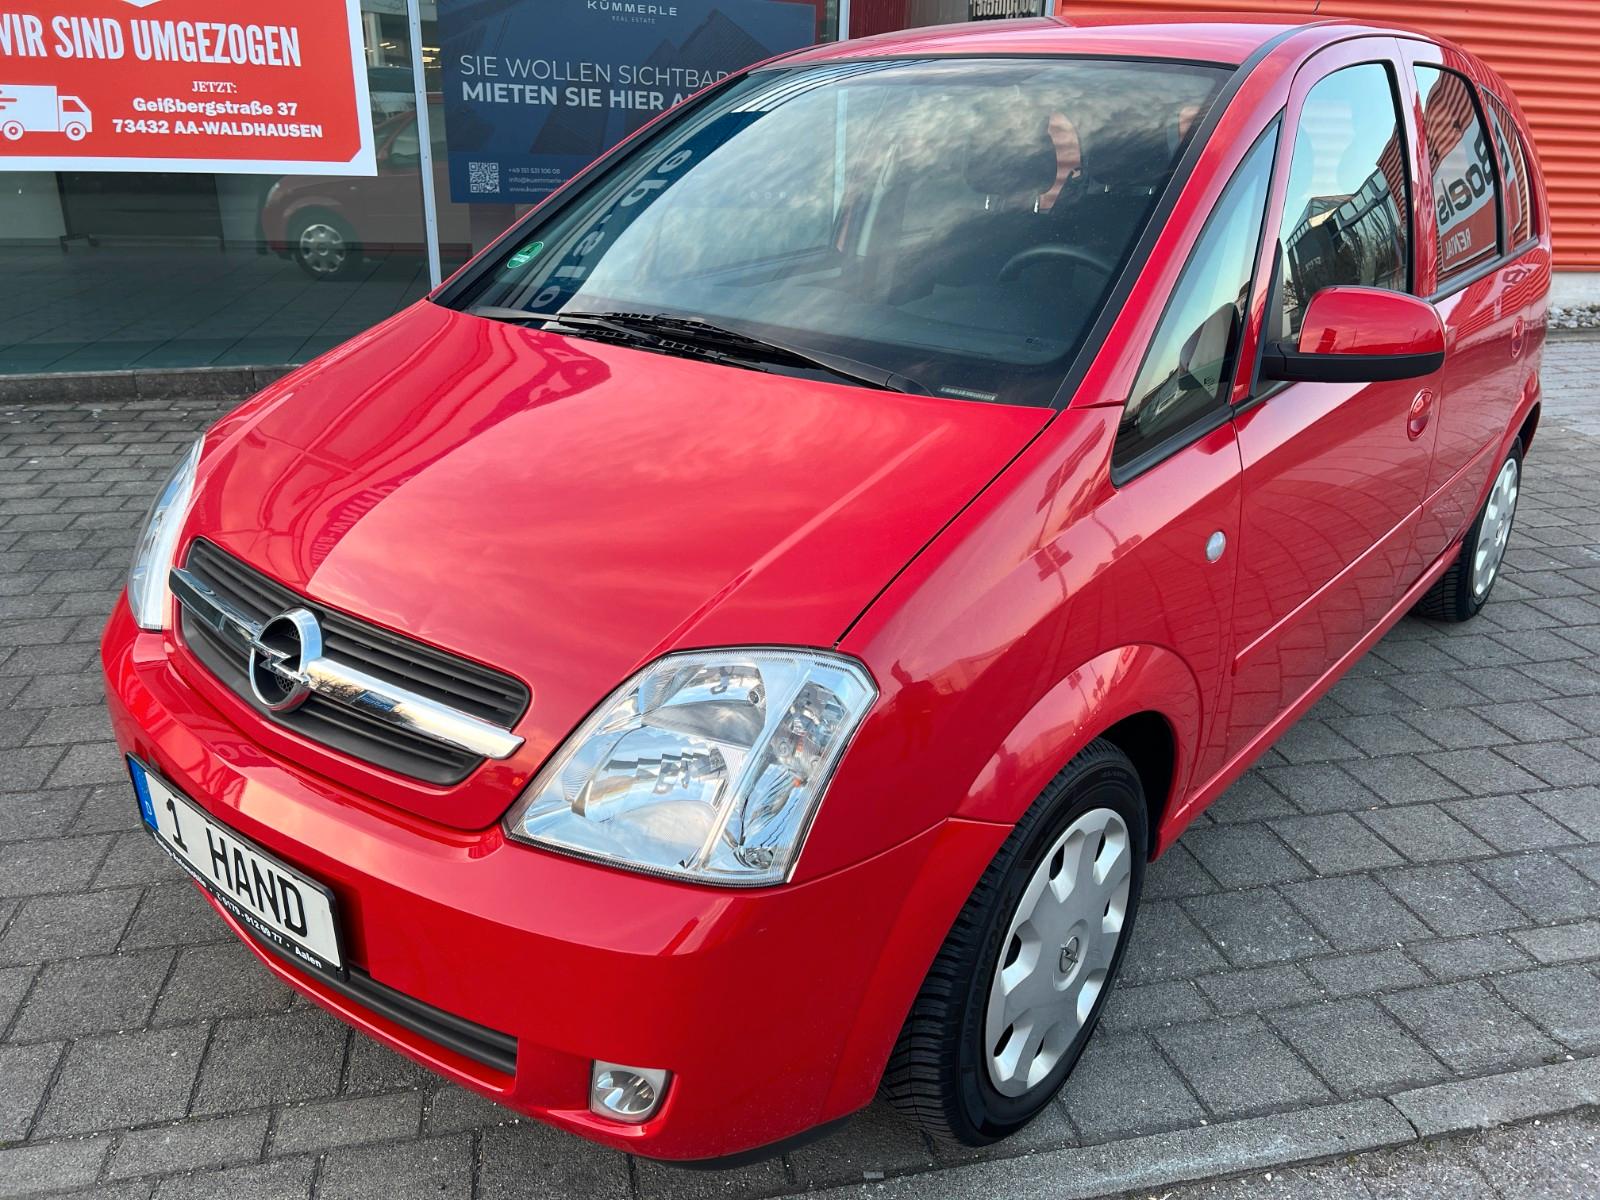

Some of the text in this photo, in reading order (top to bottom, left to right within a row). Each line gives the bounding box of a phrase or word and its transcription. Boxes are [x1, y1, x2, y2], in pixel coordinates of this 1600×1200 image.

[52, 16, 124, 59] SIND
[130, 19, 301, 67] UMGEZOGEN
[460, 54, 499, 77] SIE
[505, 57, 610, 83] WOLLEN
[192, 81, 237, 94] JETZT:
[462, 81, 558, 106] MIETEN
[565, 87, 602, 107] SIE
[609, 89, 664, 110] HIER
[133, 97, 297, 116] Geißbergstraße 37
[112, 118, 323, 138] 73432 AA-WALDHAUSEN
[166, 798, 188, 854] 1
[206, 827, 308, 938] HAND
